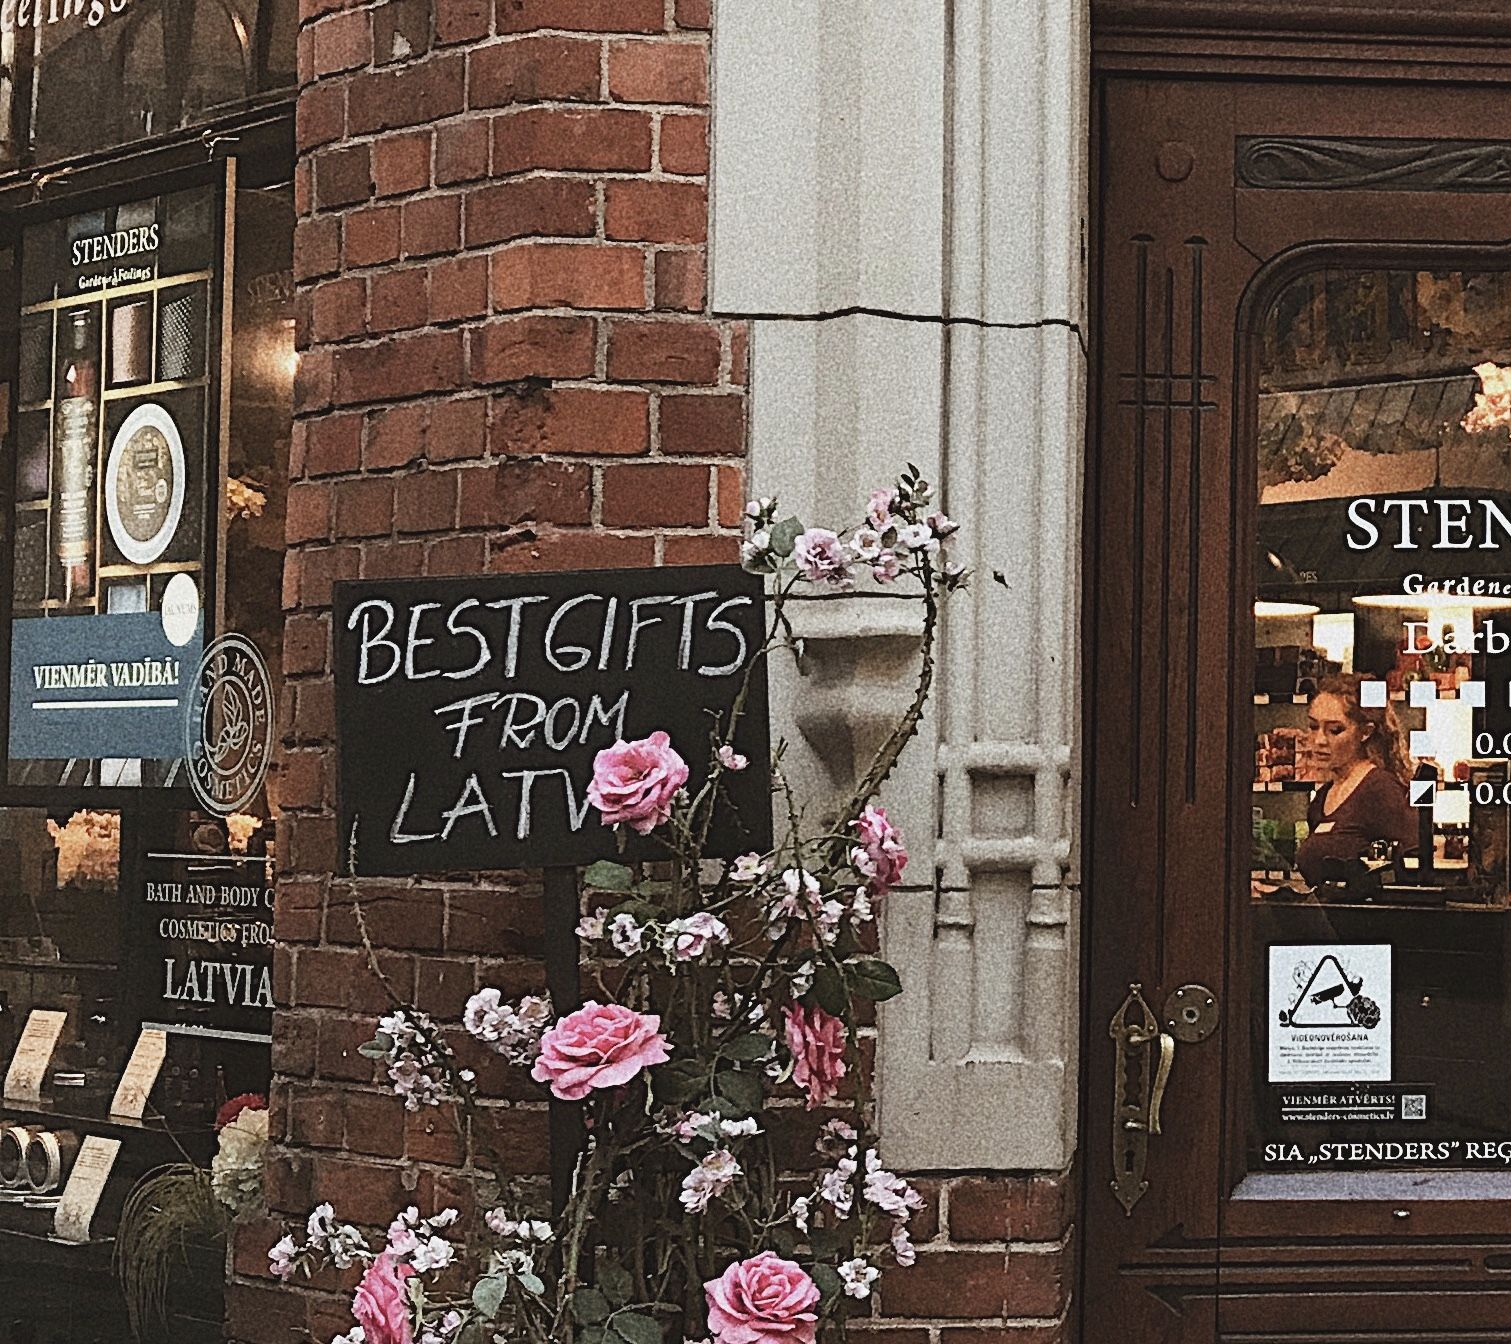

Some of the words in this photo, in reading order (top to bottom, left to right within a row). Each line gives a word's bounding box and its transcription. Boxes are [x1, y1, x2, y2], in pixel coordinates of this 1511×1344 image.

[71, 223, 160, 266] STENDERS
[347, 594, 548, 685] BEST
[545, 591, 753, 677] GIFTS
[33, 659, 108, 689] VIENMĒR
[110, 657, 180, 687] VADĪBĀ!
[234, 652, 265, 726] MADE
[434, 689, 631, 759] FROM
[389, 767, 594, 844] LATV
[146, 882, 182, 904] BATH
[186, 884, 216, 906] AND
[220, 886, 260, 908] BODY
[159, 918, 237, 943] COSMETICS
[240, 923, 275, 945] FRO
[162, 958, 276, 1008] LATVIA
[1282, 1094, 1338, 1105] VIENMĒR
[1338, 1094, 1397, 1105] ATVĒRTS!
[1264, 1143, 1305, 1162] SIA
